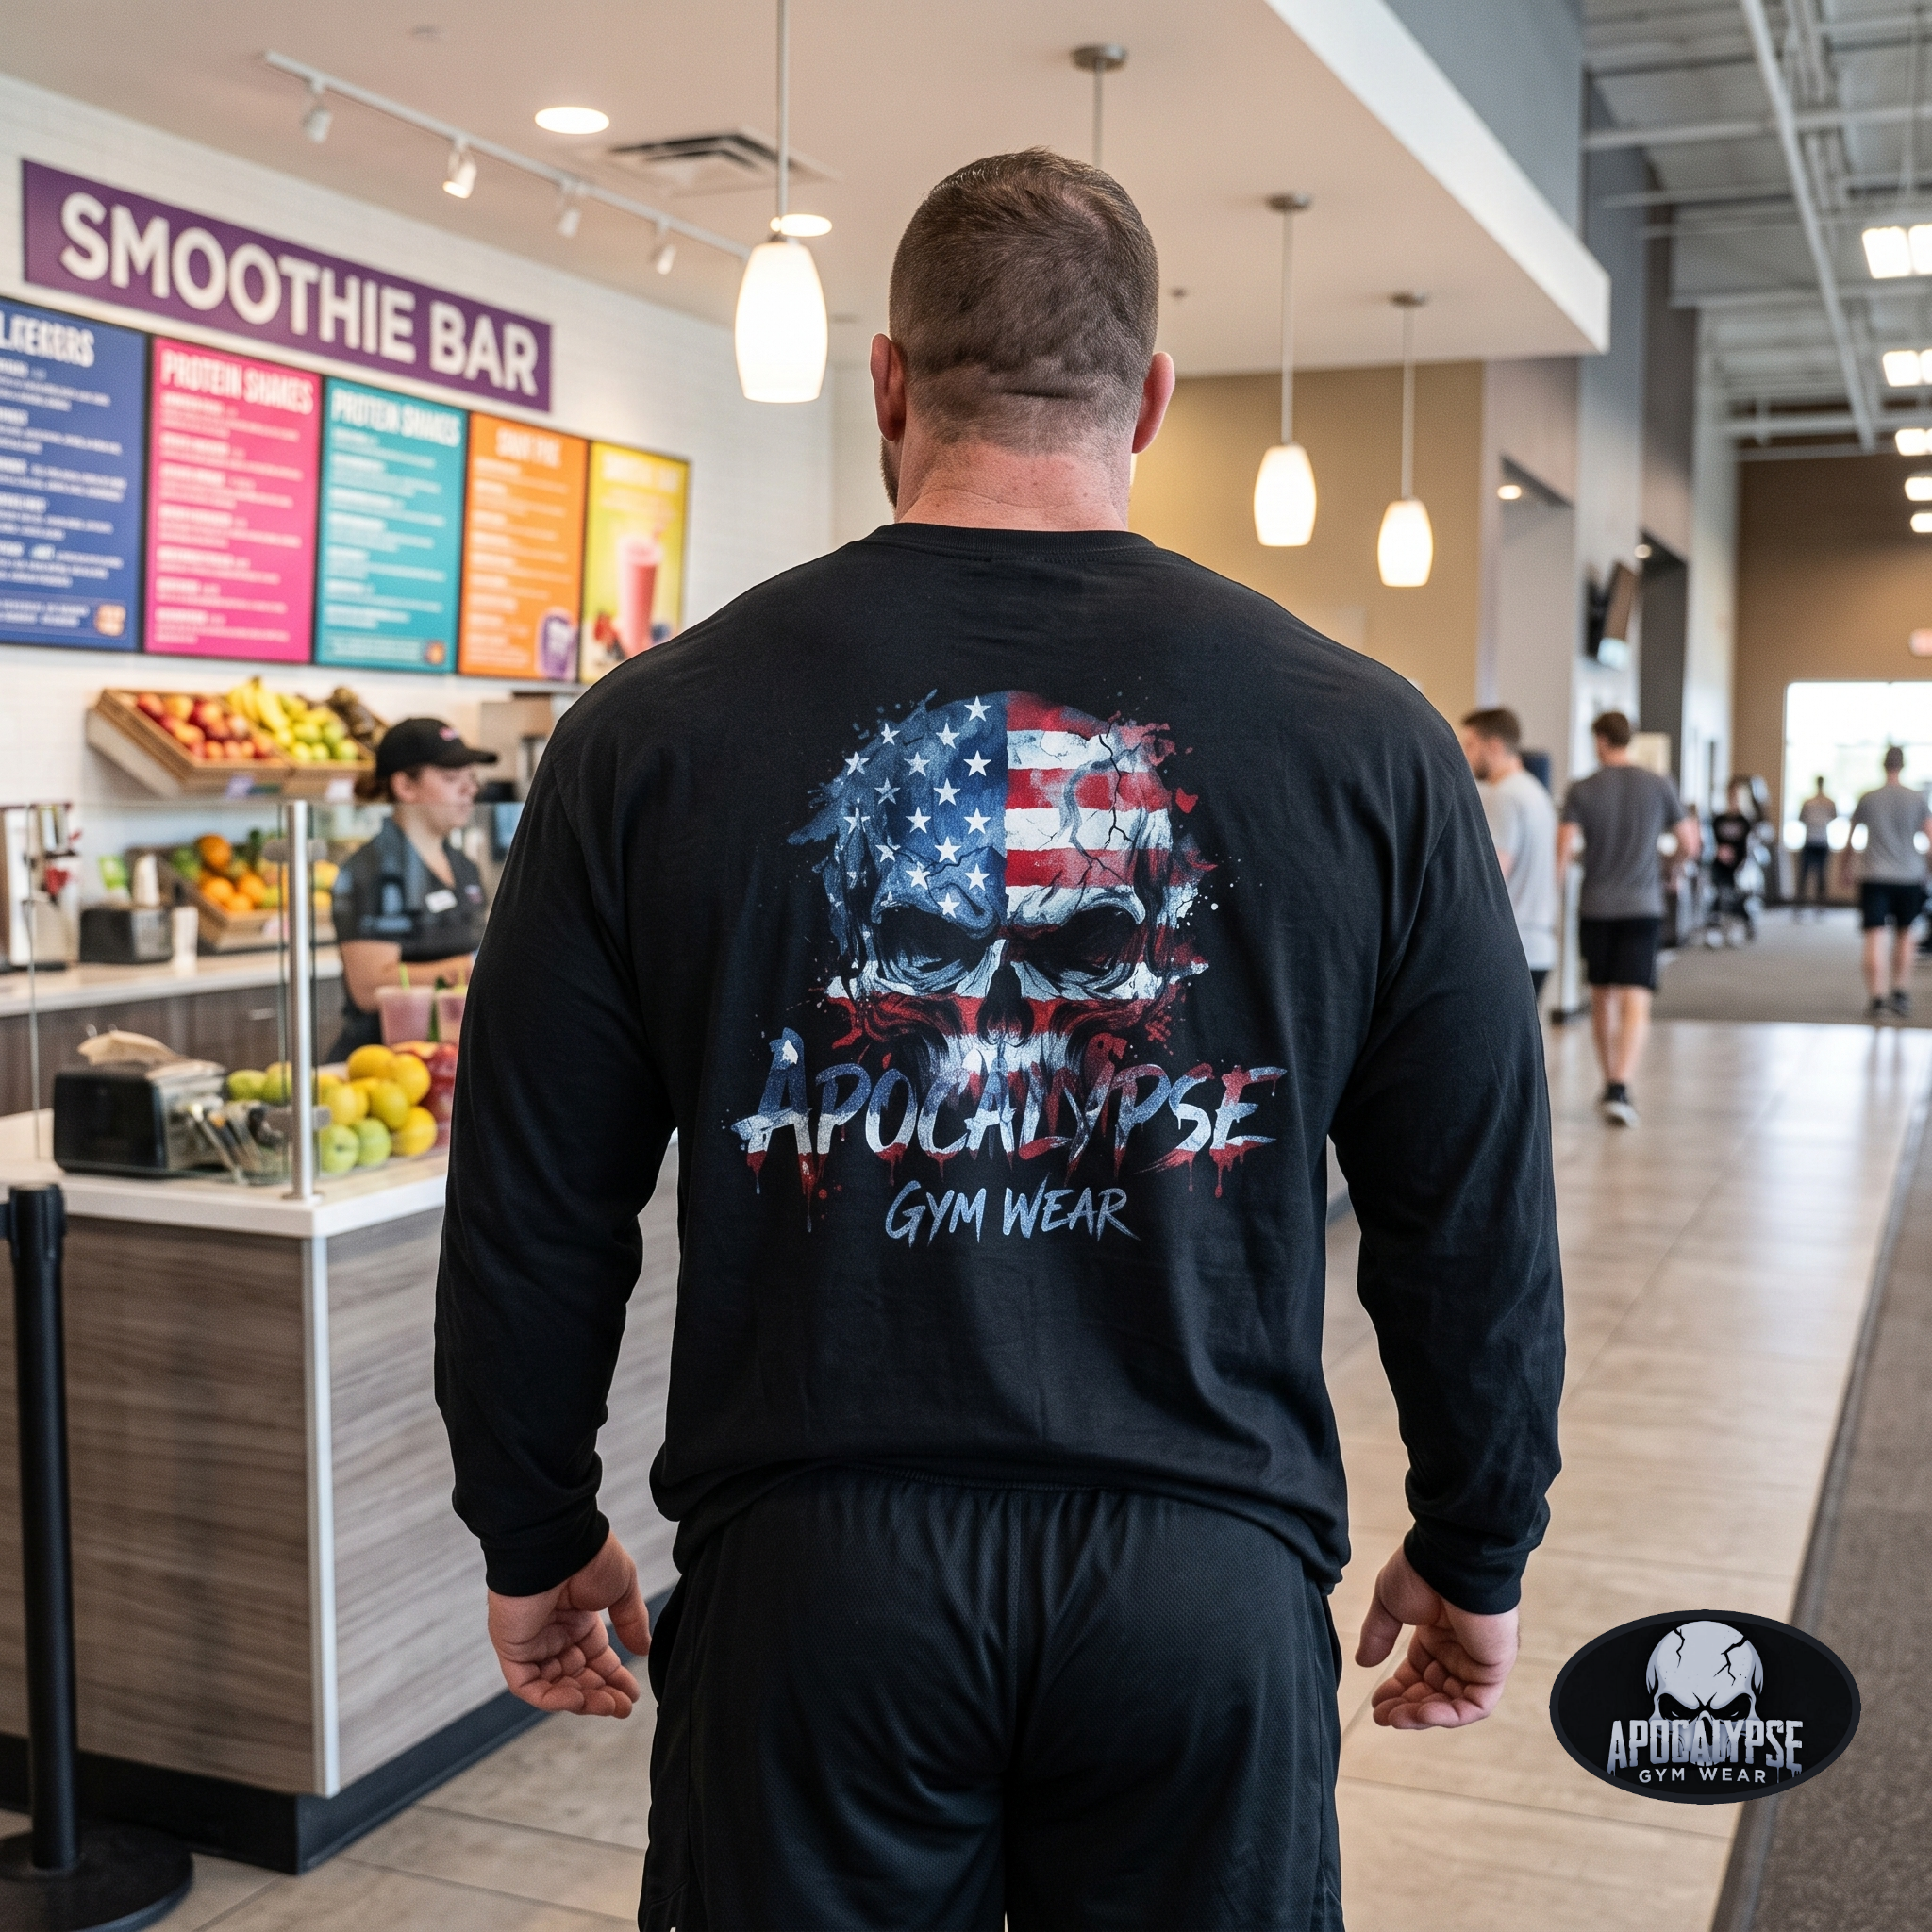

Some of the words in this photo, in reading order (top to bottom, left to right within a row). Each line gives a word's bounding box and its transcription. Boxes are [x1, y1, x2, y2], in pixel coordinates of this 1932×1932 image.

[59, 192, 417, 364] SMOOTHIE
[429, 300, 540, 397] BAR
[159, 347, 242, 400] PROTEIN
